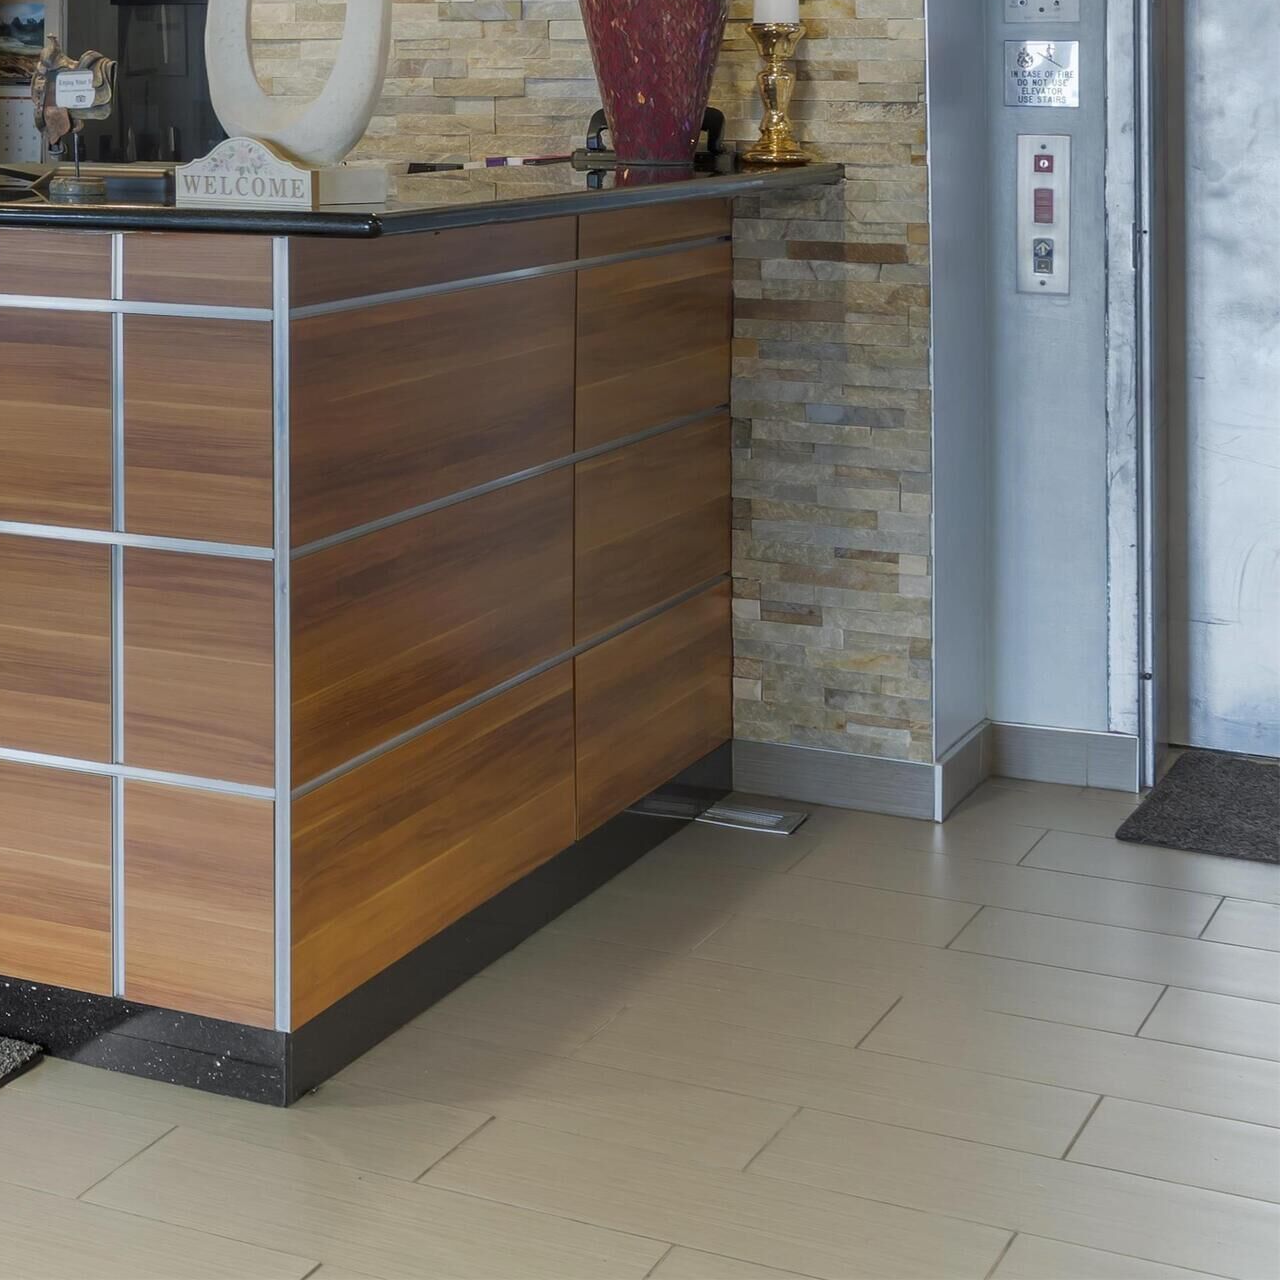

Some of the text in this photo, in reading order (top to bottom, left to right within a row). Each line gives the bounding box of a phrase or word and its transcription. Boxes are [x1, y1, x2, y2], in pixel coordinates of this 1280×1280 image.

[1018, 96, 1067, 104] USE STAIRS
[183, 174, 305, 199] WELCOME
